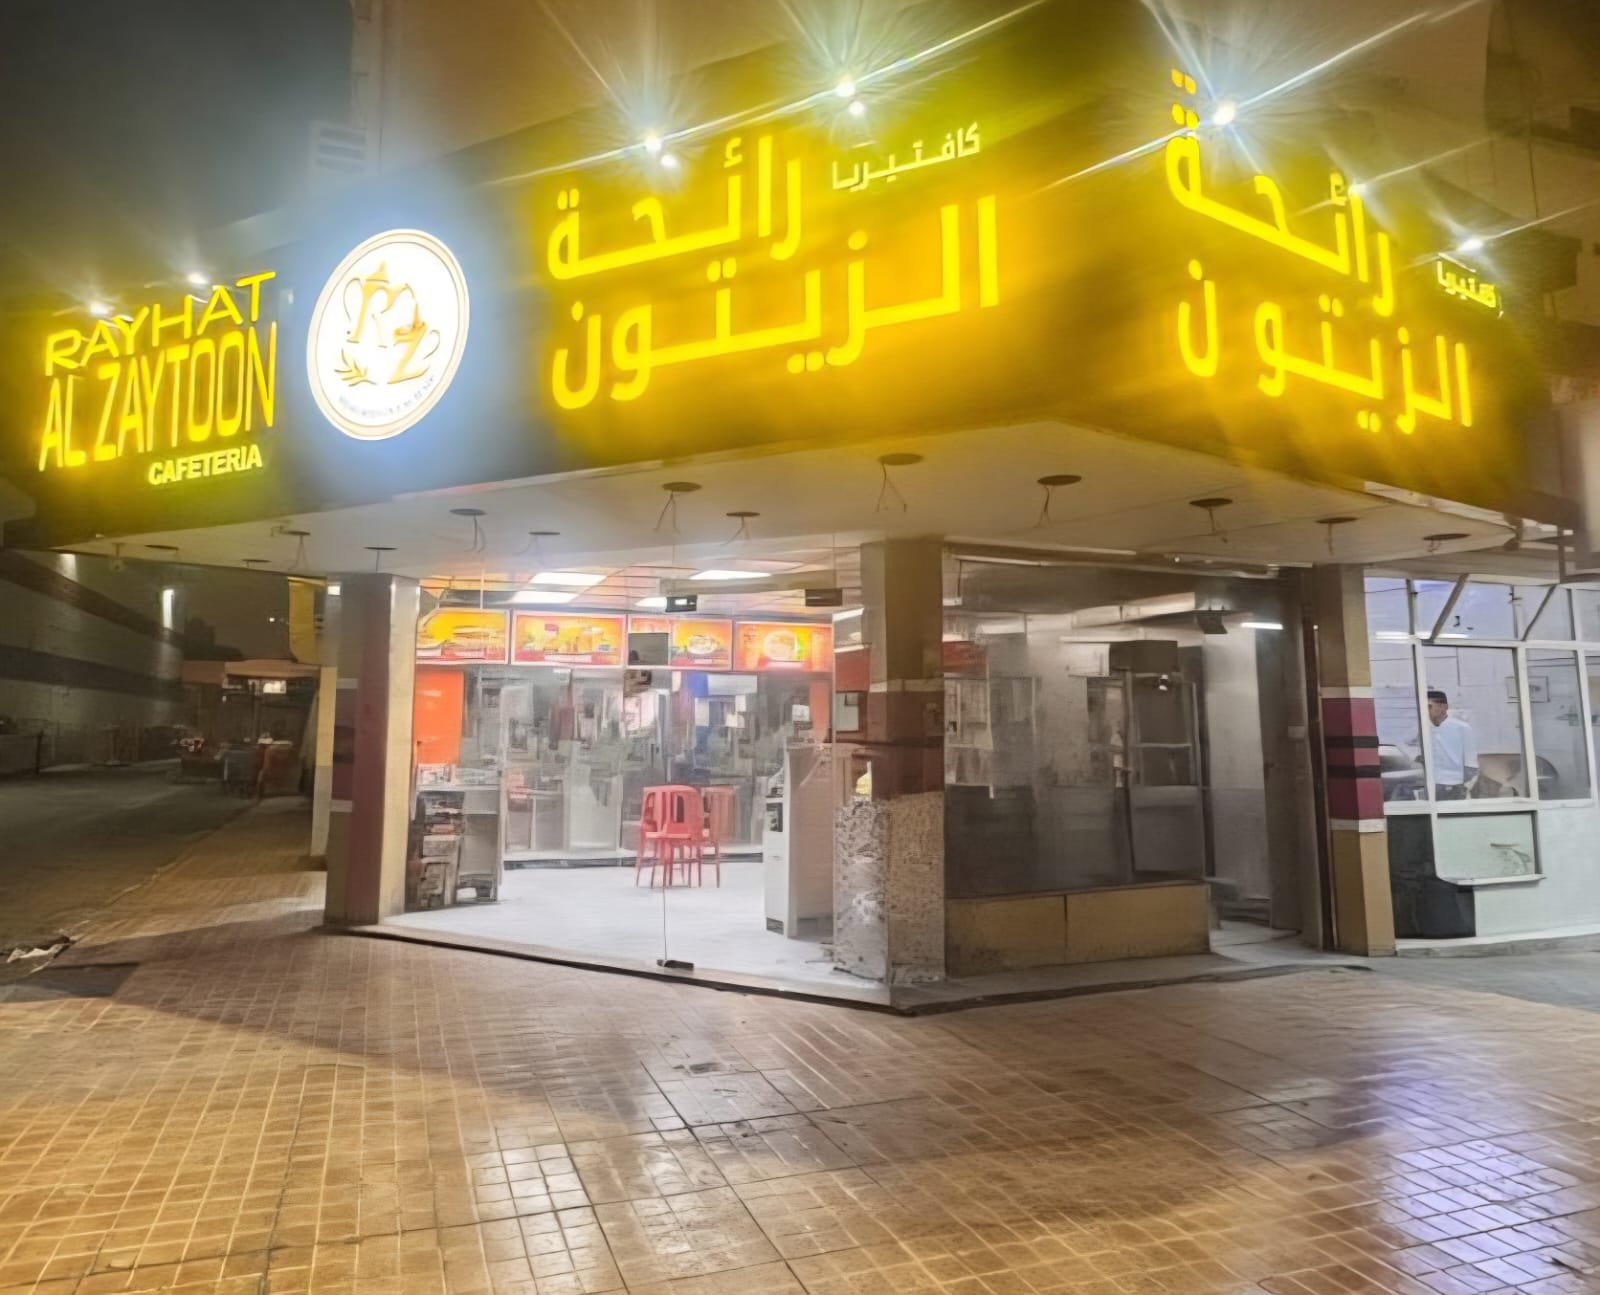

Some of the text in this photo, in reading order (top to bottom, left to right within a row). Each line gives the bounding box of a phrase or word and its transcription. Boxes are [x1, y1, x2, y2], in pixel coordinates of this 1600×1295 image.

[547, 135, 802, 281] رائحة
[1166, 100, 1394, 317] رائحة
[45, 271, 277, 376] RAYHAT
[551, 194, 1000, 410] الزيتون
[1177, 258, 1473, 434] الزيتون
[38, 320, 278, 472] AL ZAYTOON
[148, 443, 263, 486] CAFETERIA
